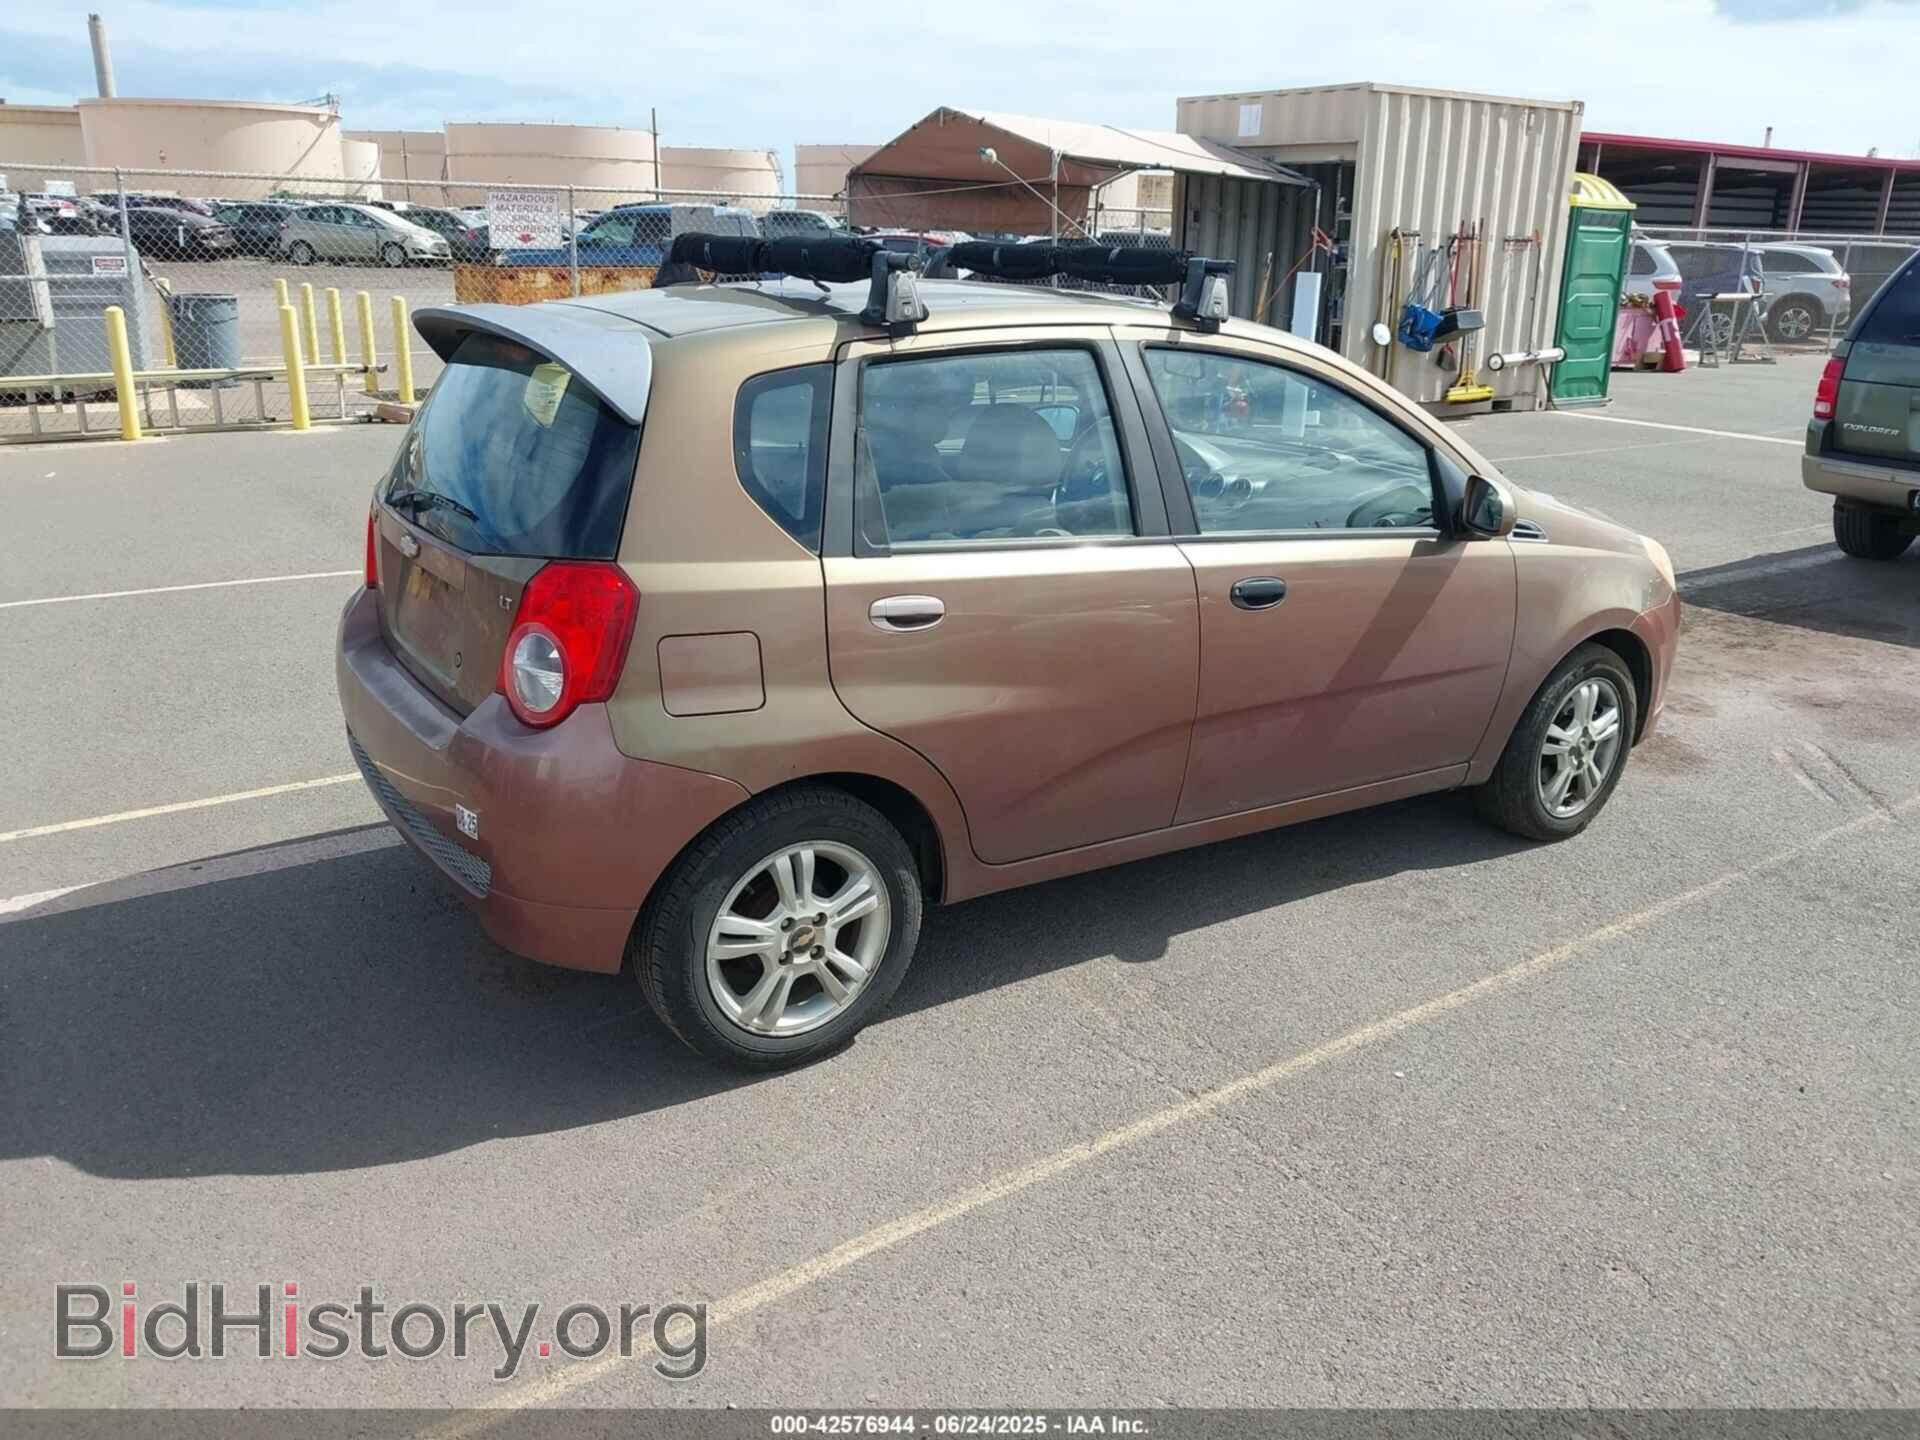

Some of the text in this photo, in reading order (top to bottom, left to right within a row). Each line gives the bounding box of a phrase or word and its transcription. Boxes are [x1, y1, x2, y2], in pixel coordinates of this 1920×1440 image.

[491, 192, 556, 204] HAZARDOUS
[495, 203, 553, 213] MATERIALS
[1843, 422, 1900, 437] EXPLORER
